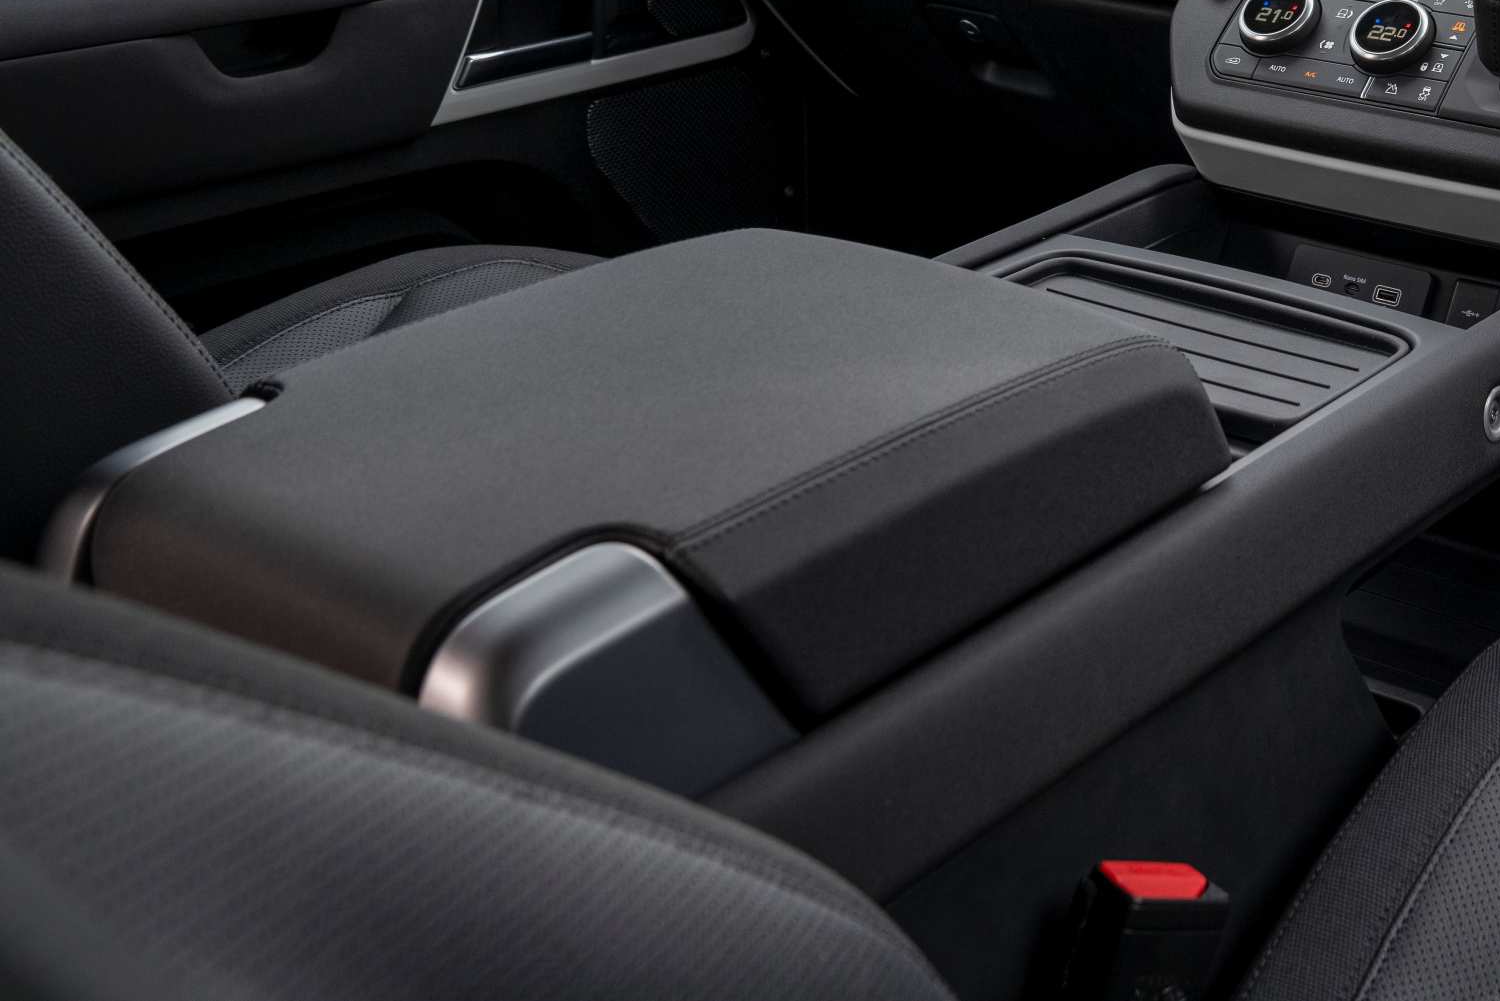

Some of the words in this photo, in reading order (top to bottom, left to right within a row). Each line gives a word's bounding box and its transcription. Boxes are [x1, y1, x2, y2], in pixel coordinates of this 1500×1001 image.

[1256, 7, 1294, 24] 21.0
[1368, 24, 1407, 41] 22.0
[1269, 64, 1287, 73] AUTO
[1336, 75, 1355, 85] AUTO
